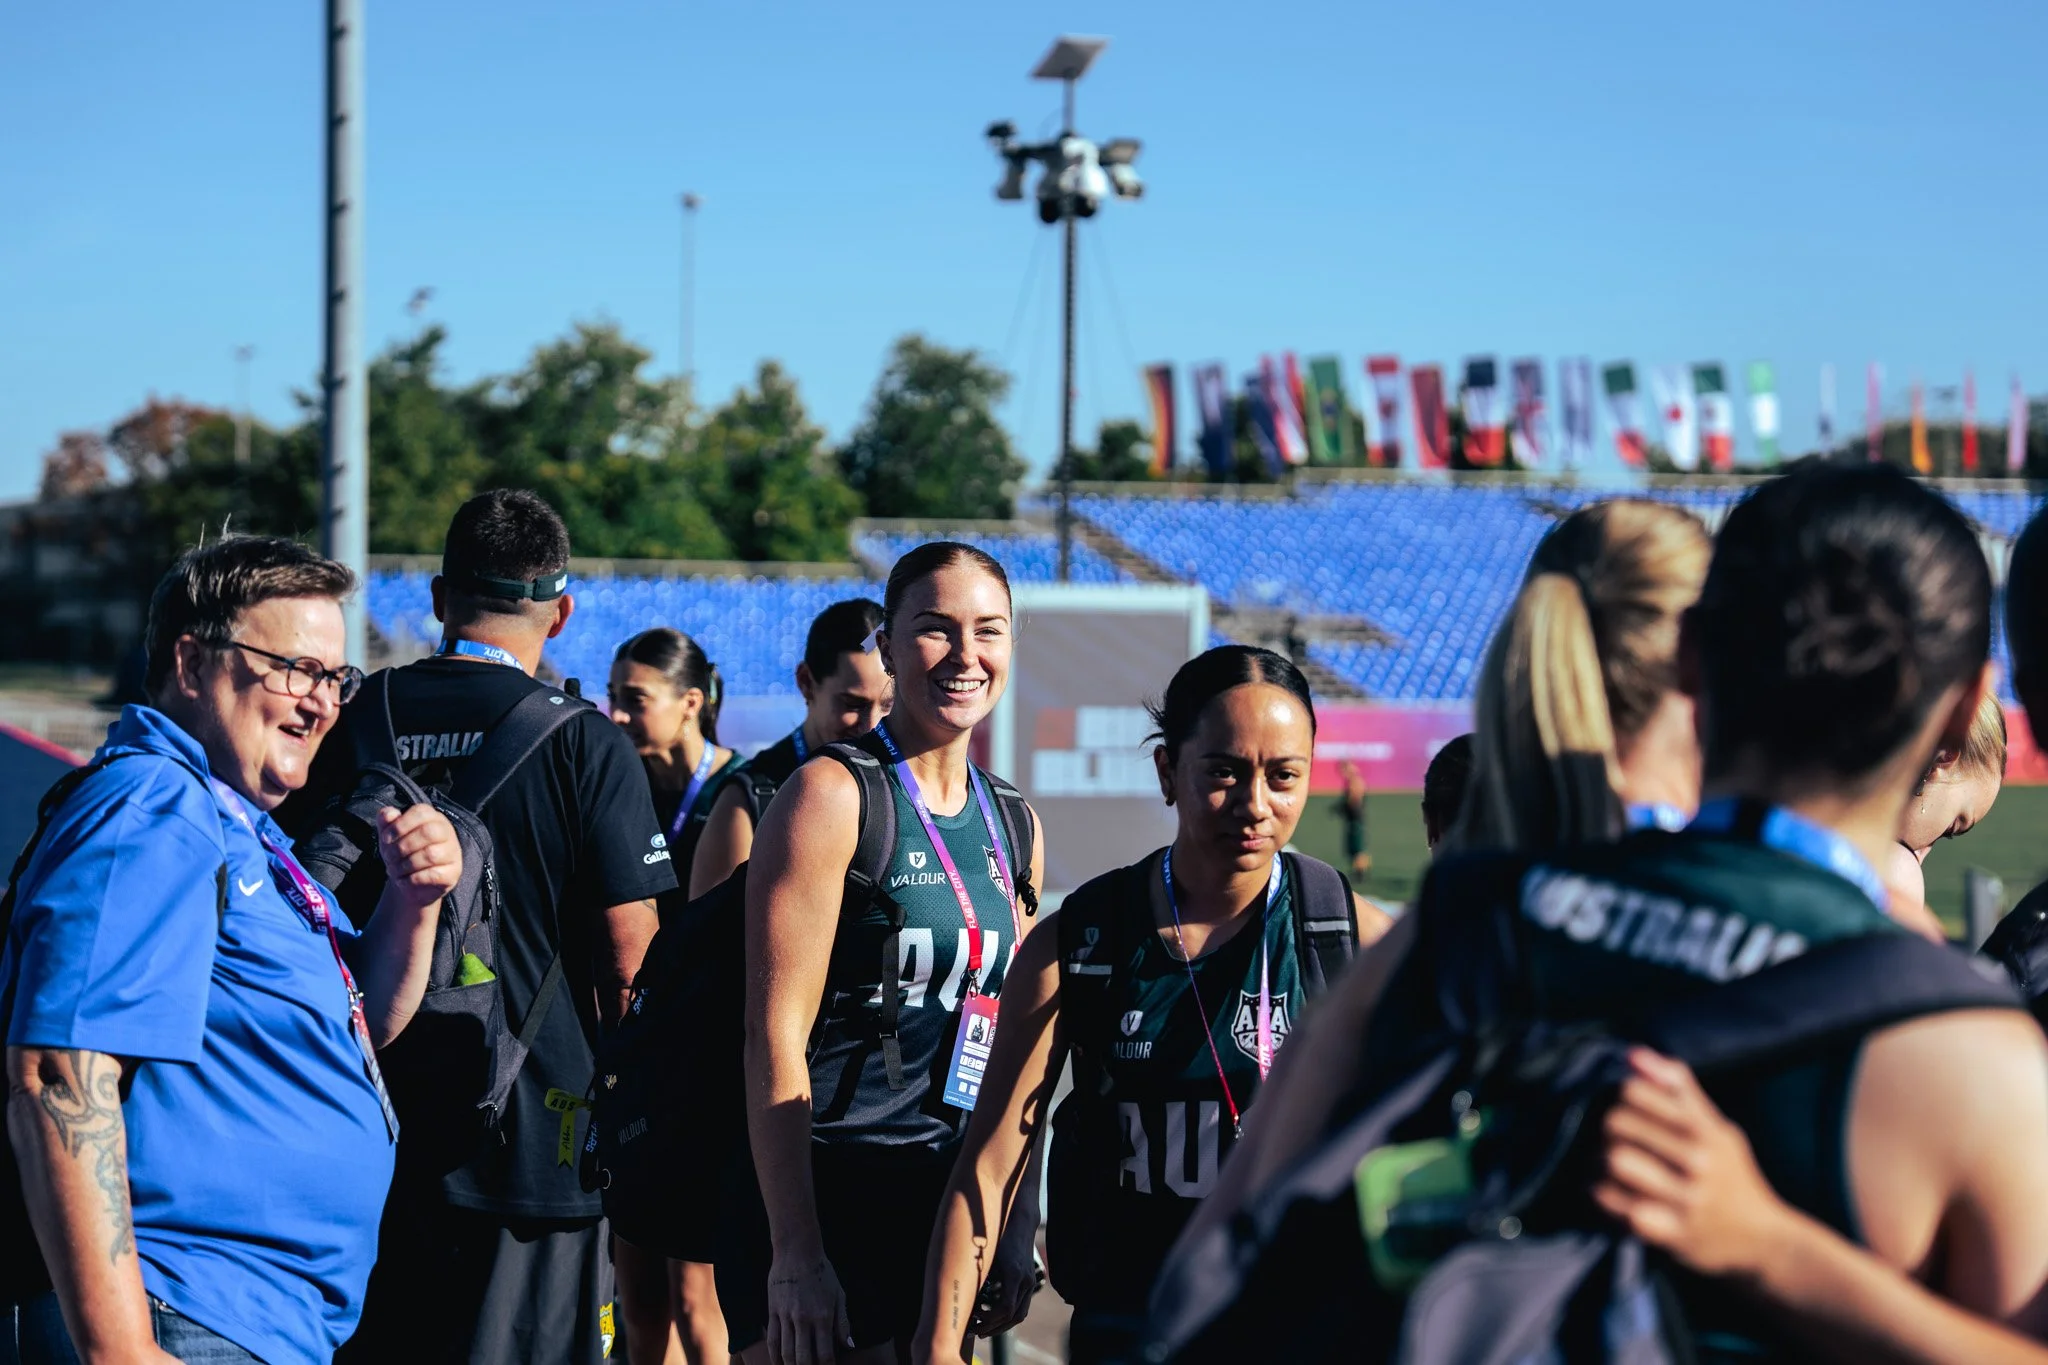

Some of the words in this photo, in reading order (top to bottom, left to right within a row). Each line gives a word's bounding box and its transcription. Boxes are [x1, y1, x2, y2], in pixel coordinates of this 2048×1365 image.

[396, 732, 484, 760] STRALIA
[643, 850, 671, 865] Galla
[890, 872, 947, 888] VALOUR
[957, 890, 970, 906] THE
[965, 907, 977, 929] FLAG
[550, 1098, 576, 1112] AUS
[617, 1117, 649, 1148] VALOUR
